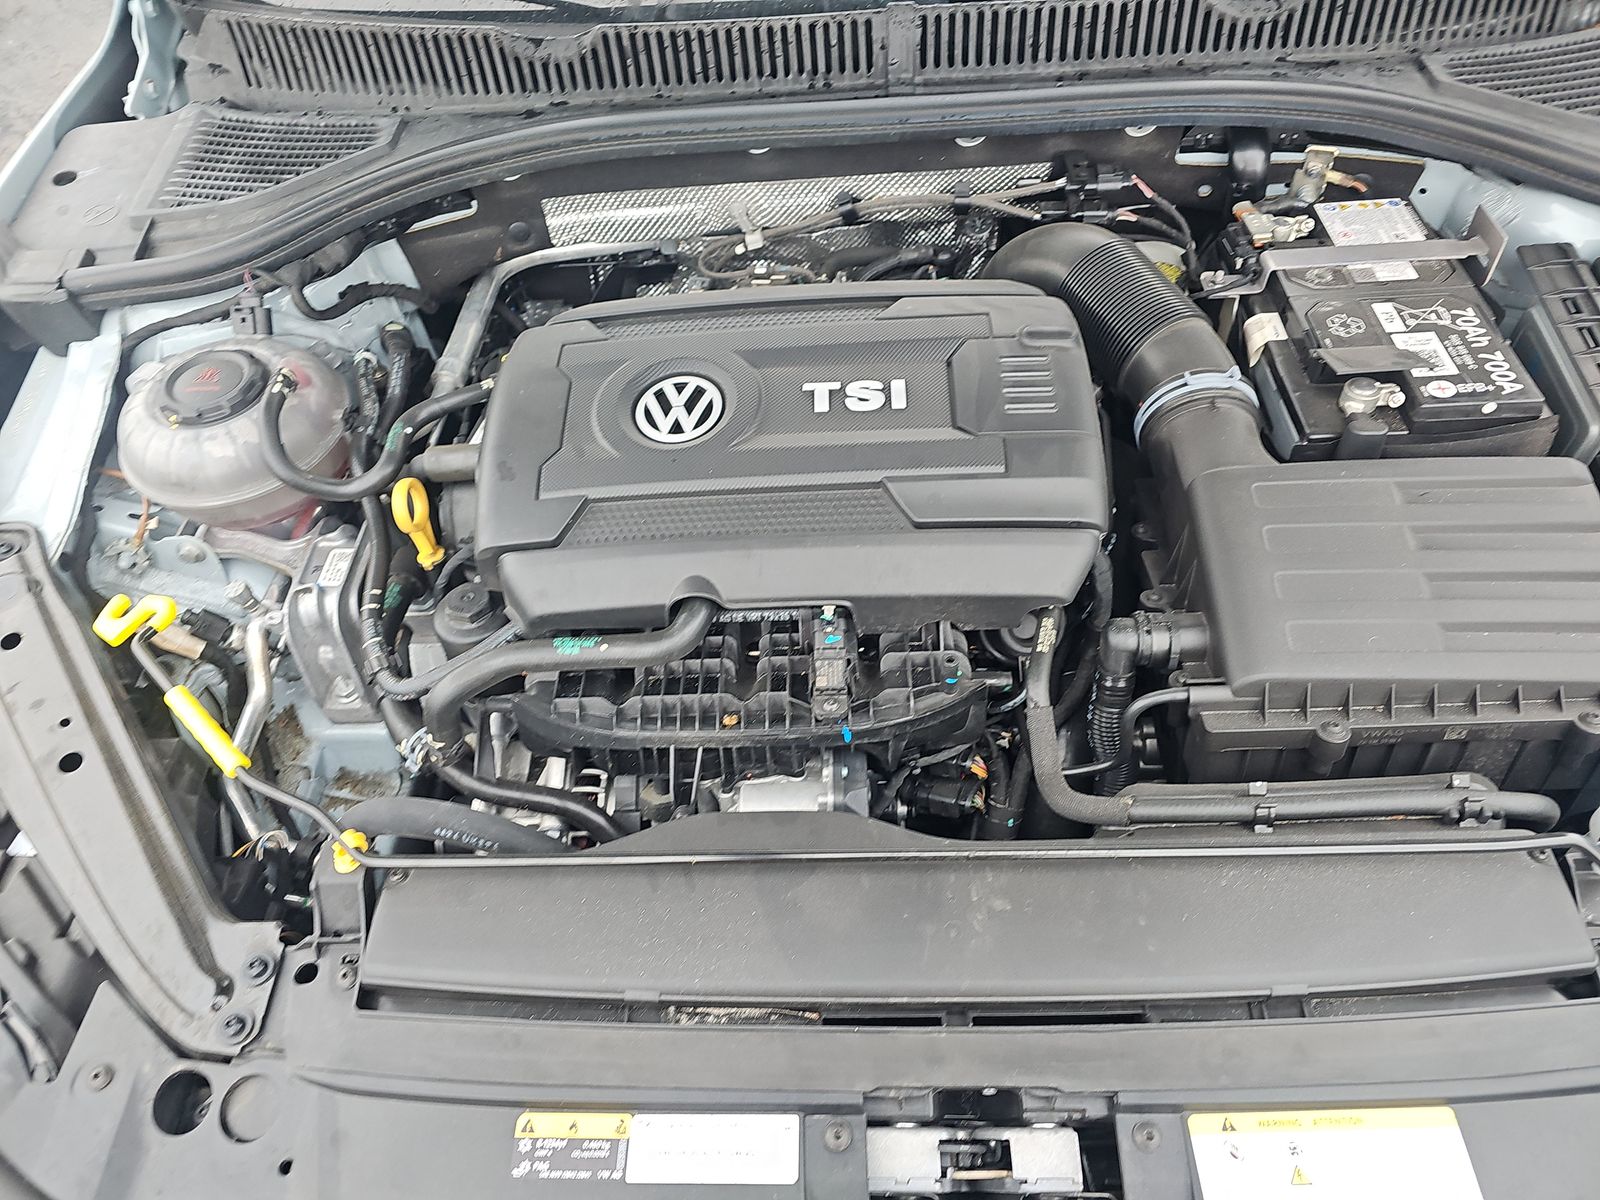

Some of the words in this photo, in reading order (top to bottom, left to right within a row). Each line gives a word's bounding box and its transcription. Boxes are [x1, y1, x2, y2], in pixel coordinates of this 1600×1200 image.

[1450, 306, 1492, 347] 70Ah
[1477, 350, 1525, 395] 700A
[801, 378, 908, 413] TSI
